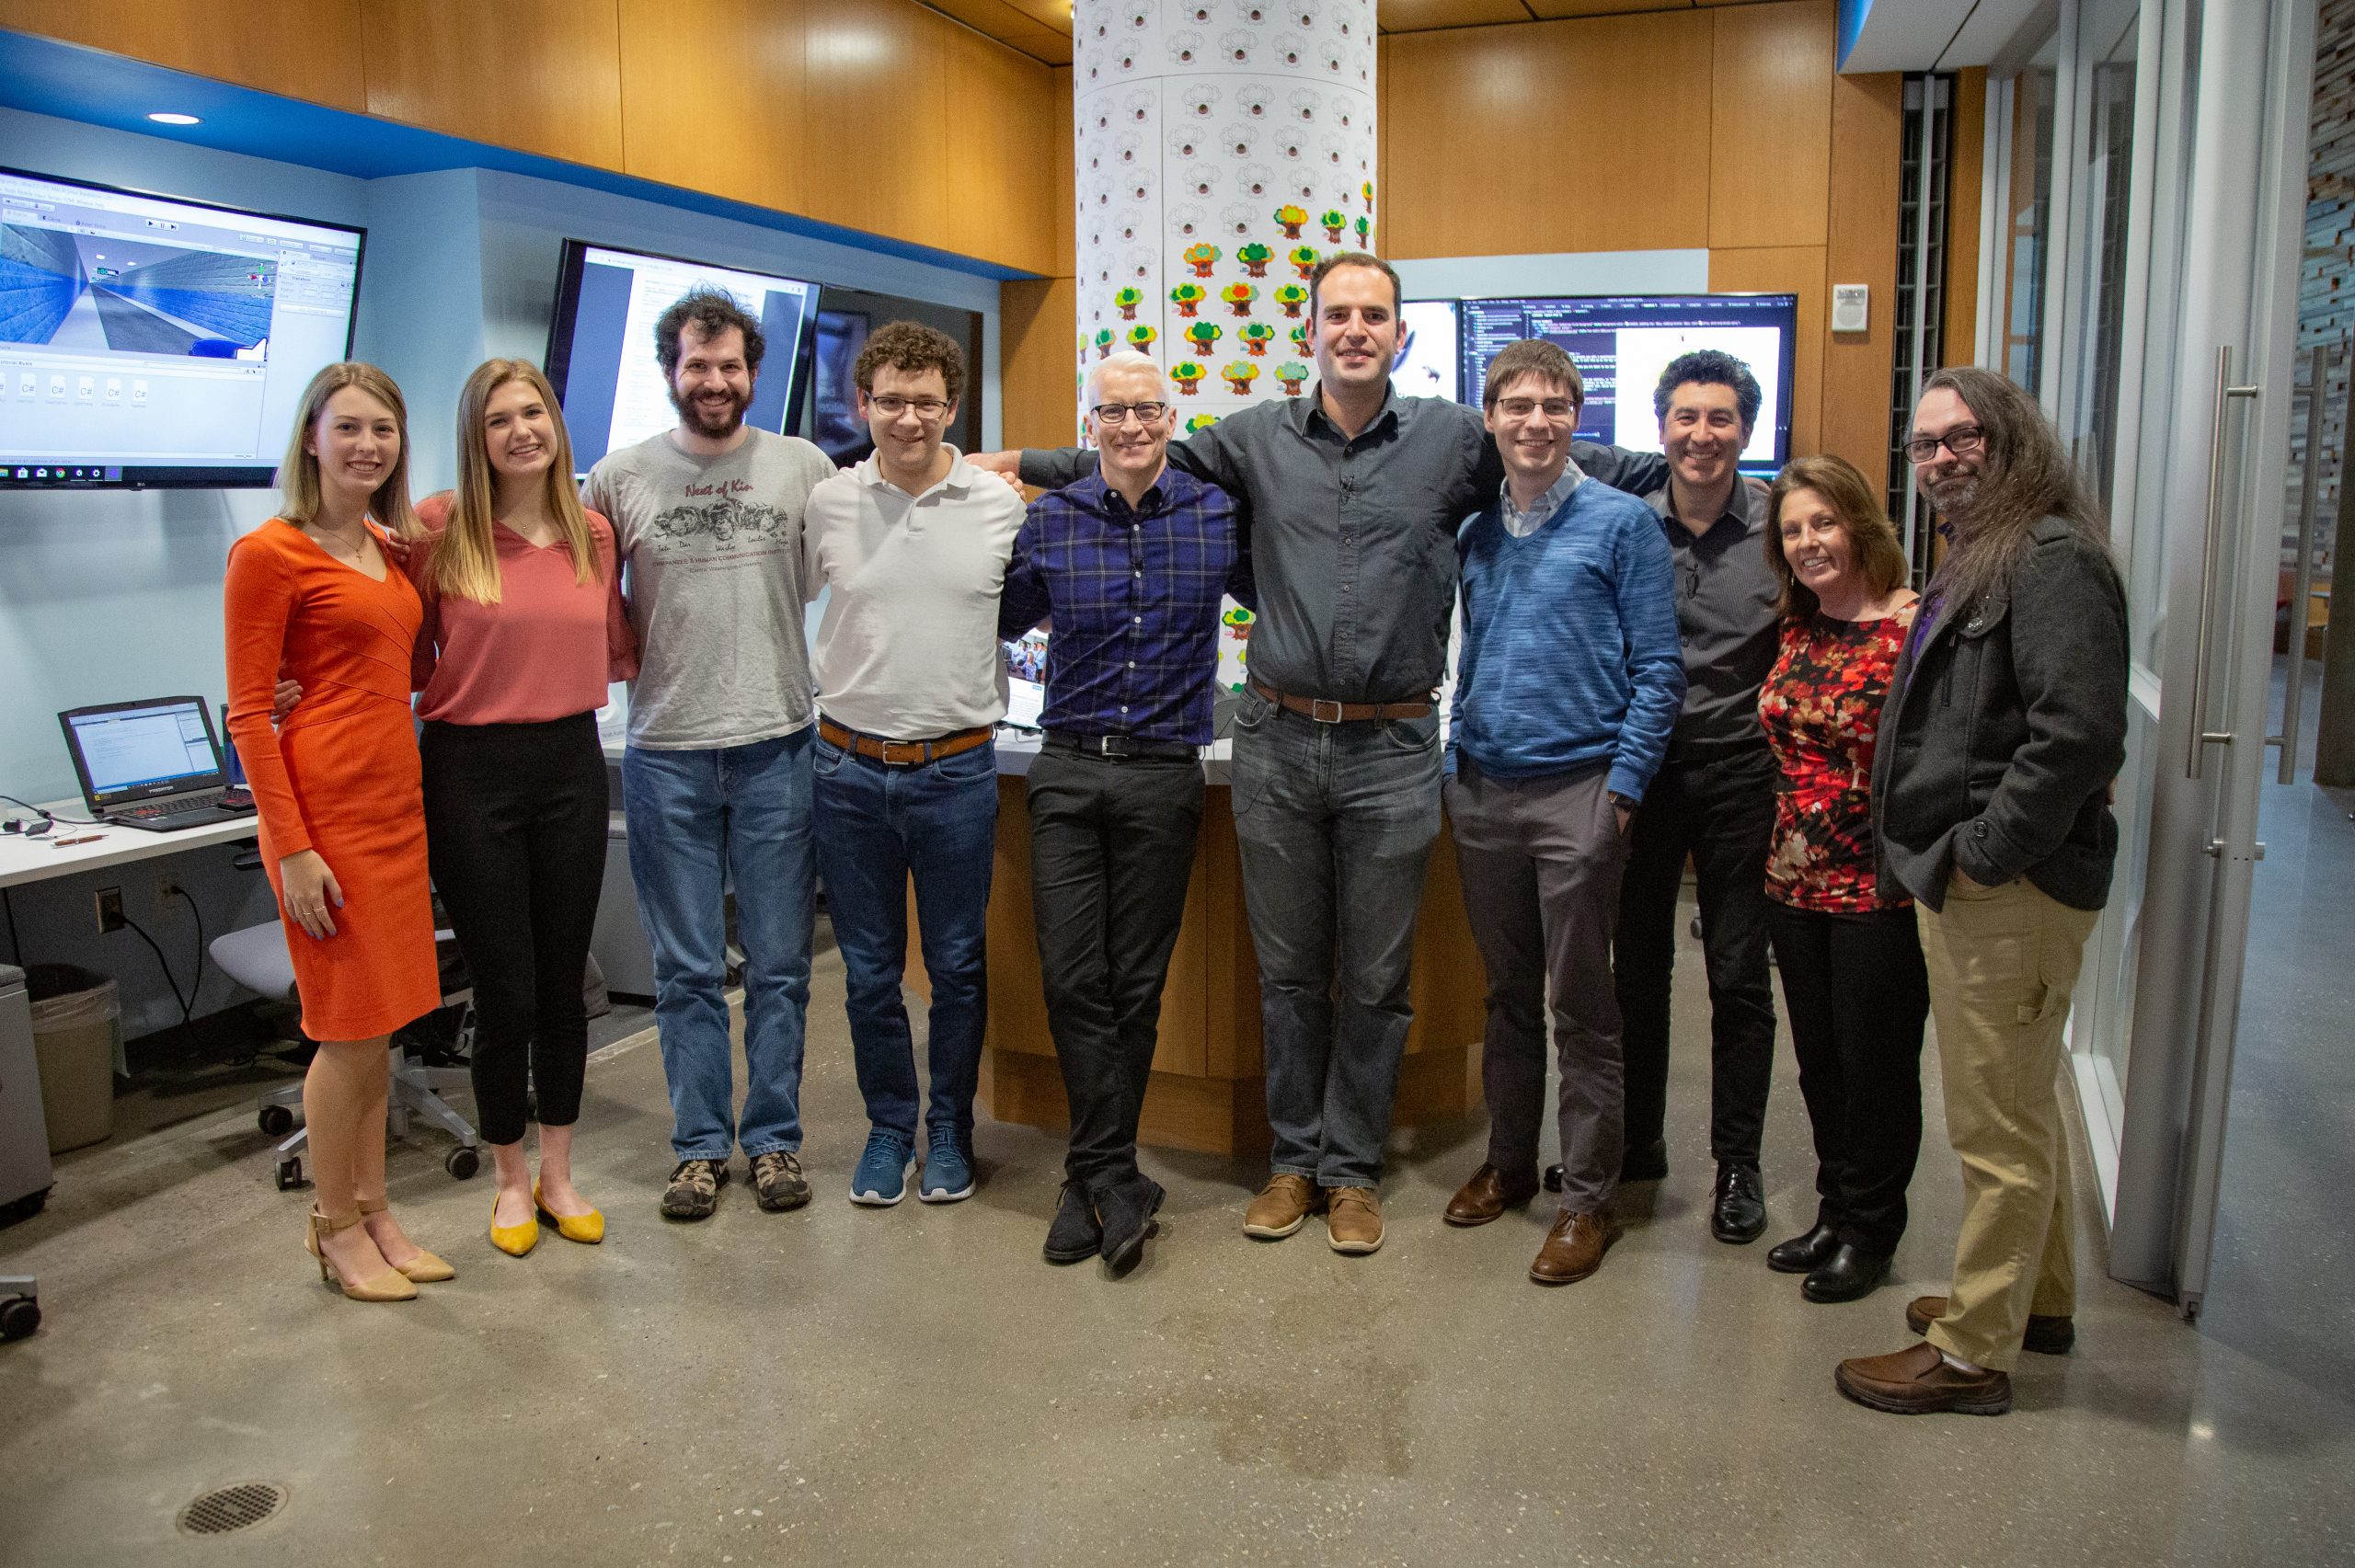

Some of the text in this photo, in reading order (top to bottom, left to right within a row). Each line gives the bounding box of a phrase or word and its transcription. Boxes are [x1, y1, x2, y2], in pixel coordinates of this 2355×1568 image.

[685, 478, 753, 498] Next of Kin
[718, 550, 766, 561] COMMUNICATION
